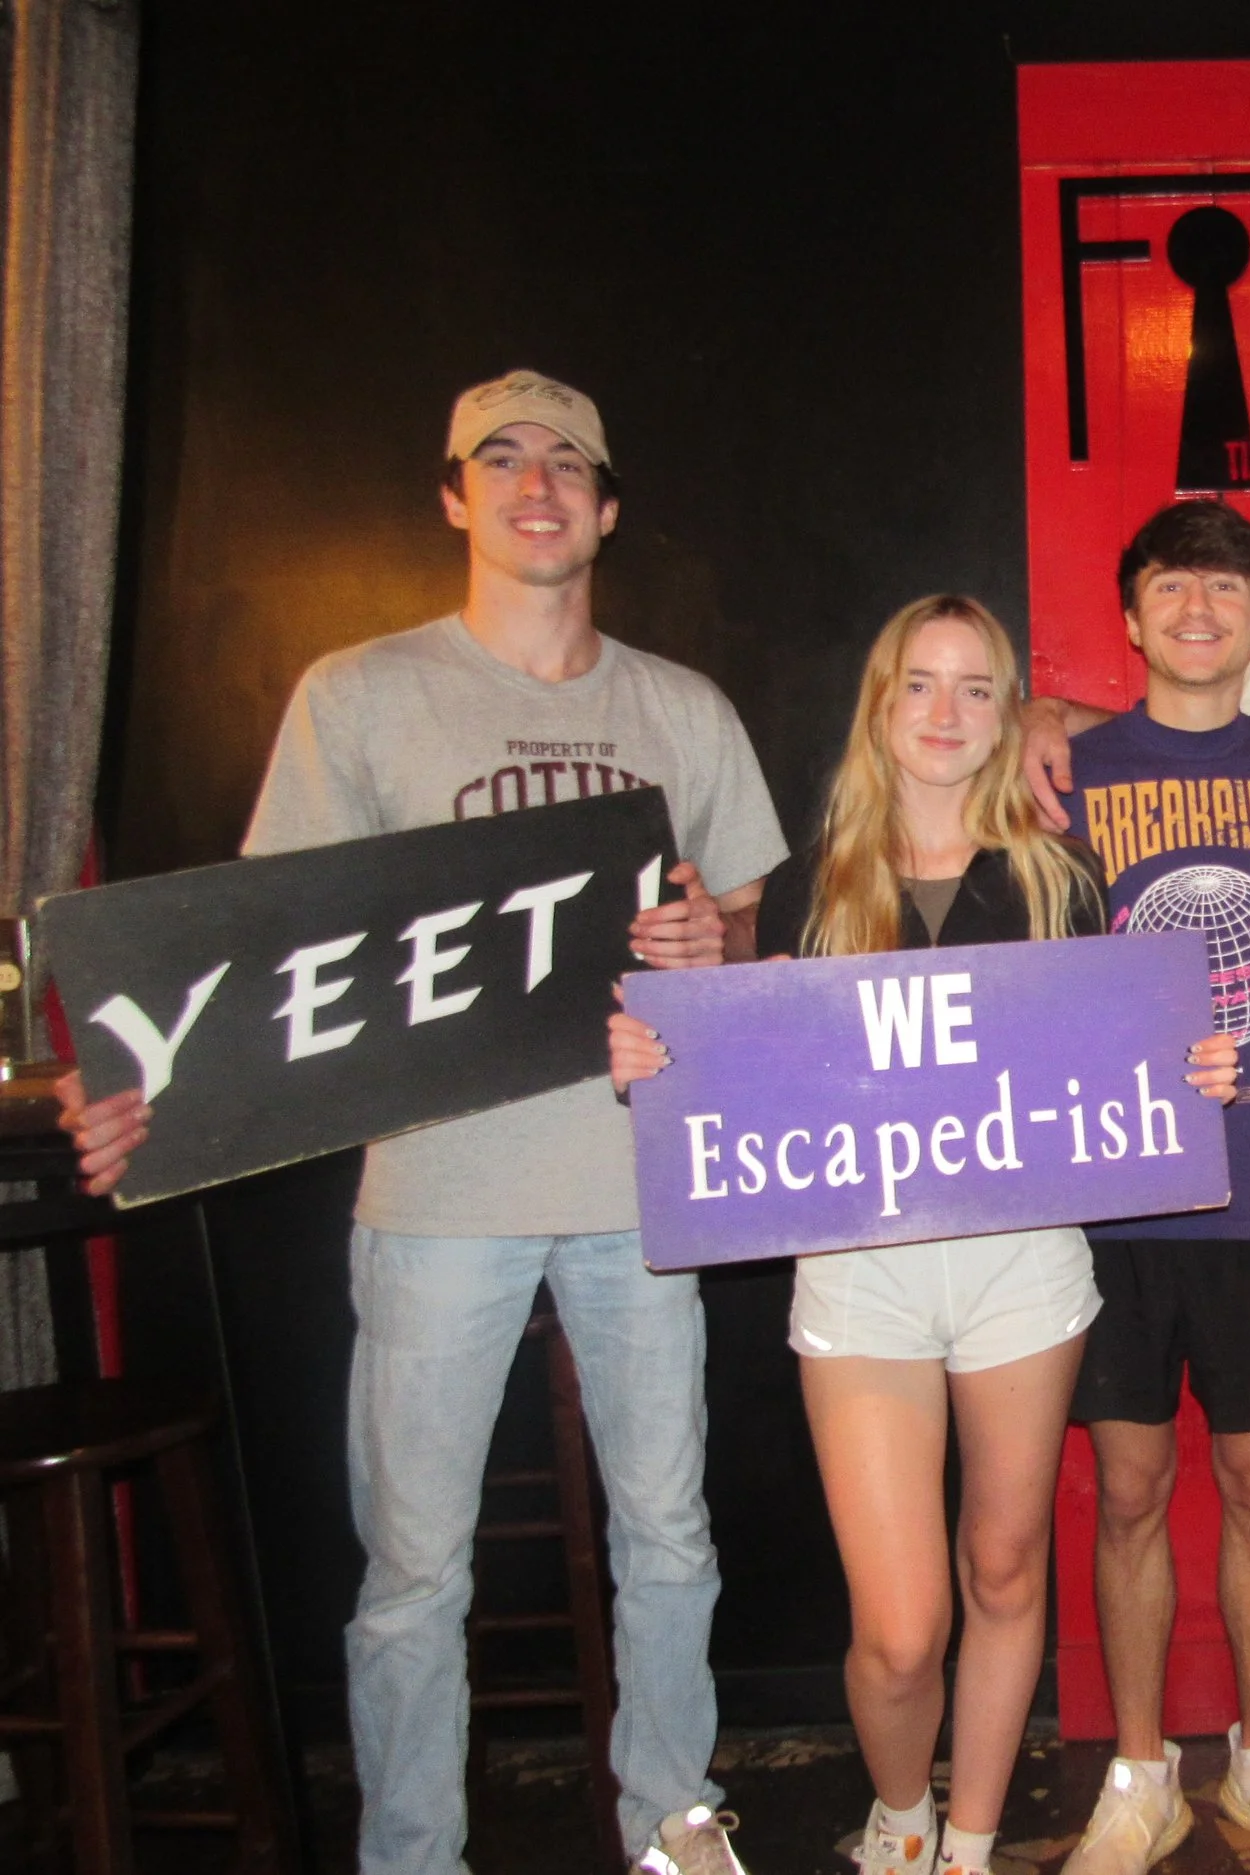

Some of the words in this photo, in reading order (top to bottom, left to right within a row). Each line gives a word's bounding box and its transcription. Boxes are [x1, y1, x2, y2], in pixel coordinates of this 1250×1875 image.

[506, 740, 595, 757] PROPERTY
[599, 741, 617, 757] OF
[857, 972, 978, 1072] WE
[684, 1060, 1185, 1217] Escaped-ish
